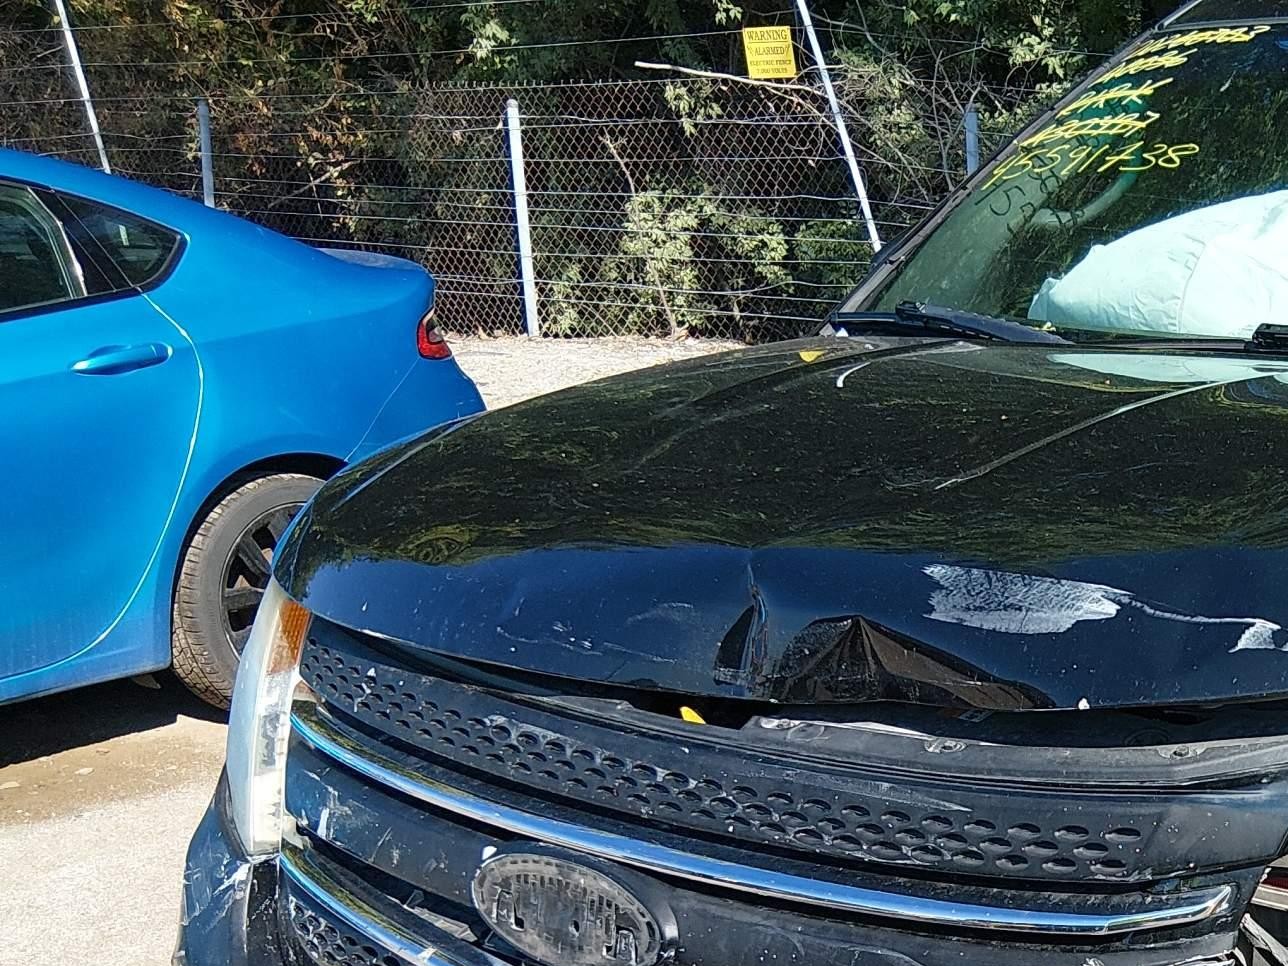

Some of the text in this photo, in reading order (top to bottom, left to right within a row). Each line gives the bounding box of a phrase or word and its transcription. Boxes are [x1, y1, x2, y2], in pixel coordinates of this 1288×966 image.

[746, 29, 788, 41] WARNING
[755, 46, 785, 56] ALARMED
[980, 141, 1200, 191] 45591738
